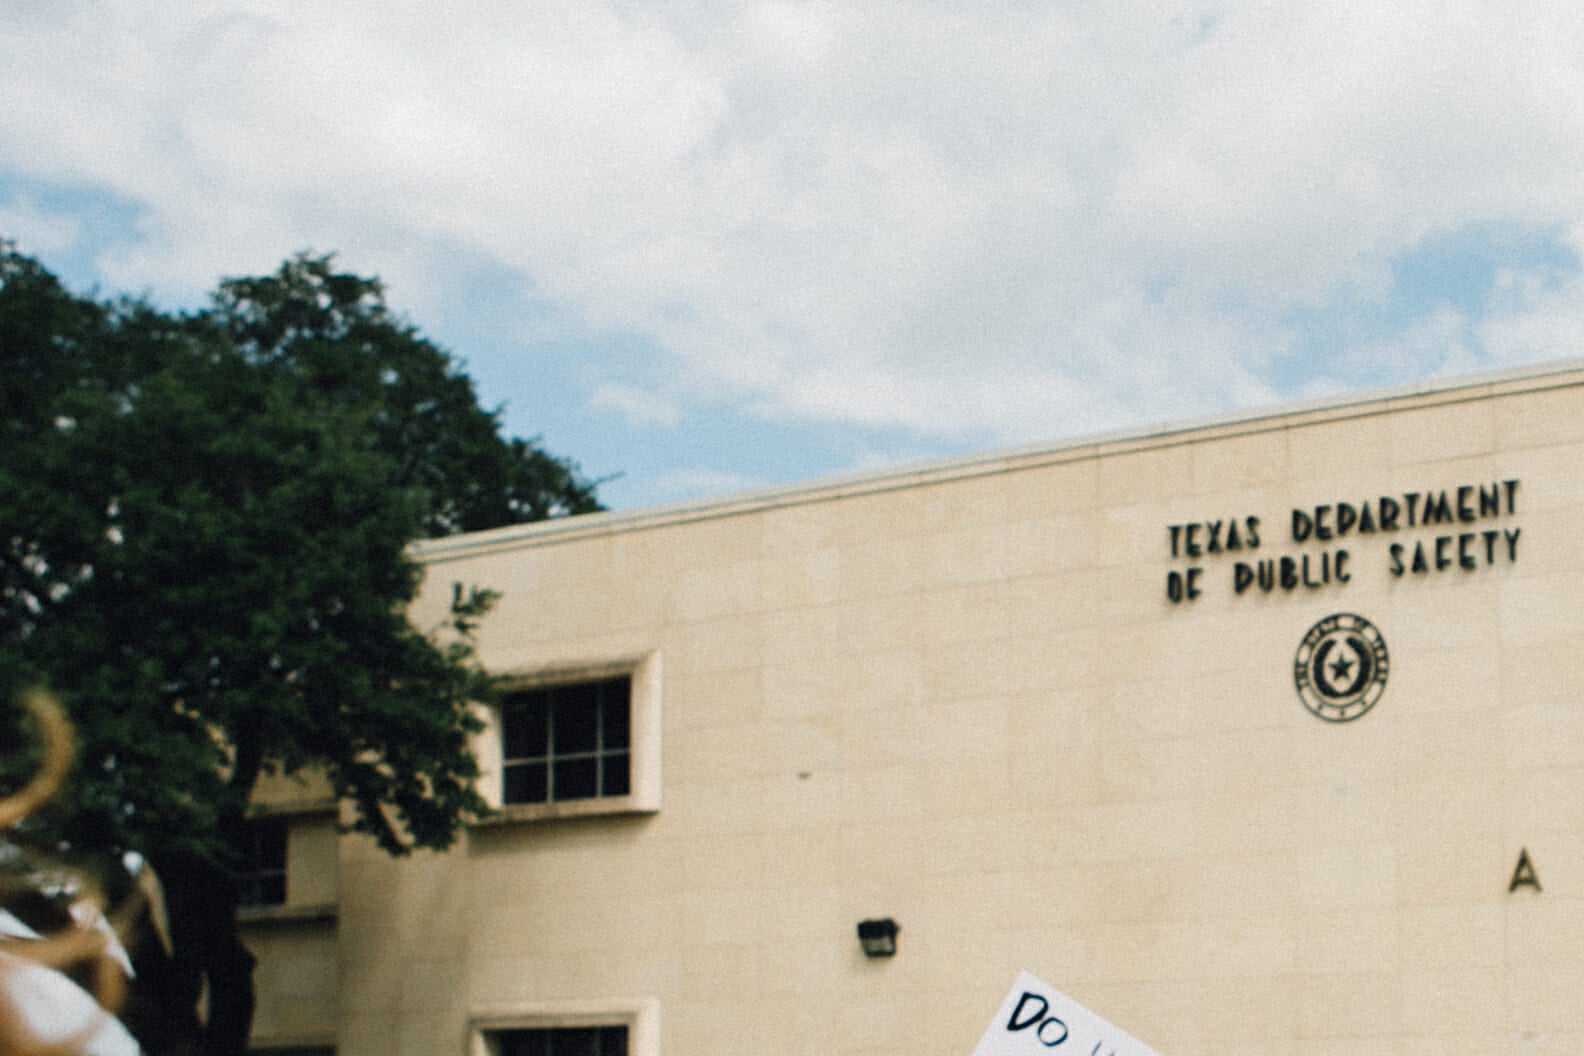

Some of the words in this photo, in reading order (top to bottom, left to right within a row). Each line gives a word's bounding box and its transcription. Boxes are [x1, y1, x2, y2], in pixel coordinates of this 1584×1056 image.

[1166, 515, 1260, 558] TEXAS
[1291, 479, 1521, 544] DEPARTMENT
[1166, 566, 1204, 604] OF
[1233, 549, 1352, 595] PUBLIC
[1388, 527, 1521, 578] SAFETY
[1508, 846, 1543, 895] A
